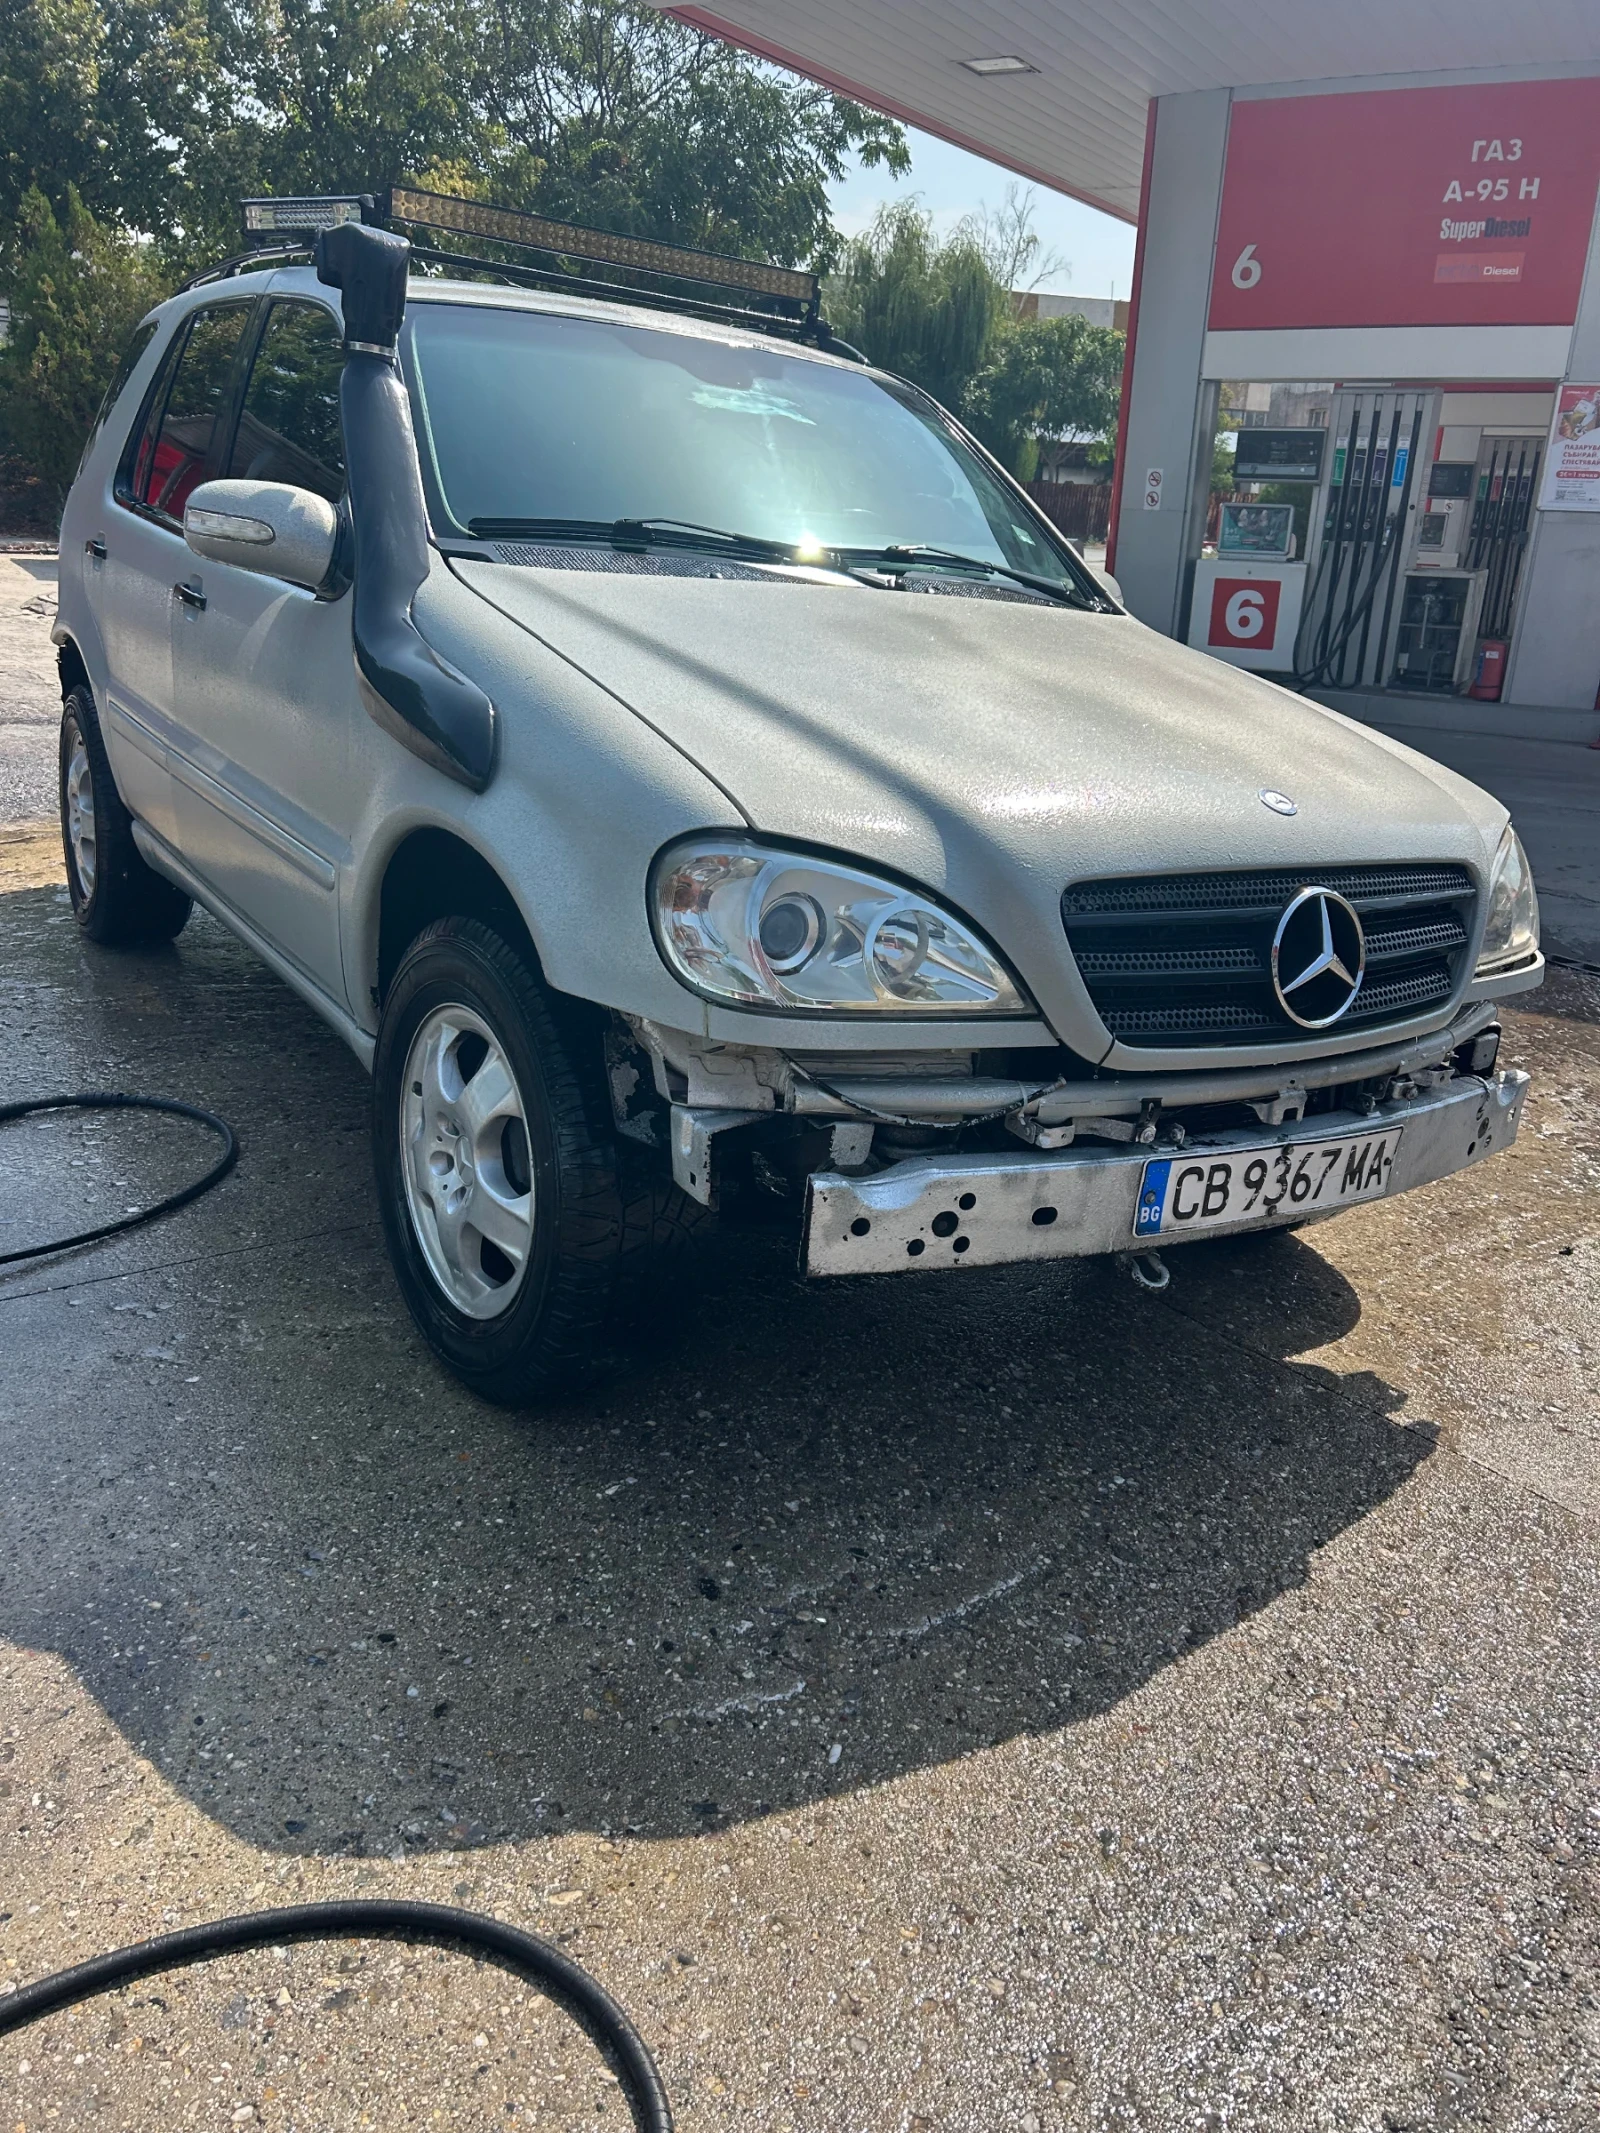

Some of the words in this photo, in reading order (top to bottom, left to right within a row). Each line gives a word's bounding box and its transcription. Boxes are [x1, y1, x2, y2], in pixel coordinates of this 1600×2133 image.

[1471, 138, 1523, 162] ГАЗ
[1442, 178, 1509, 203] А-95
[1518, 177, 1540, 200] Н
[1231, 244, 1262, 289] 6
[1483, 266, 1519, 276] Diesel
[1224, 589, 1265, 639] 6
[1172, 1163, 1232, 1220] CB
[1242, 1147, 1343, 1212] 9367
[1340, 1139, 1387, 1194] MA
[1139, 1205, 1160, 1224] BG
